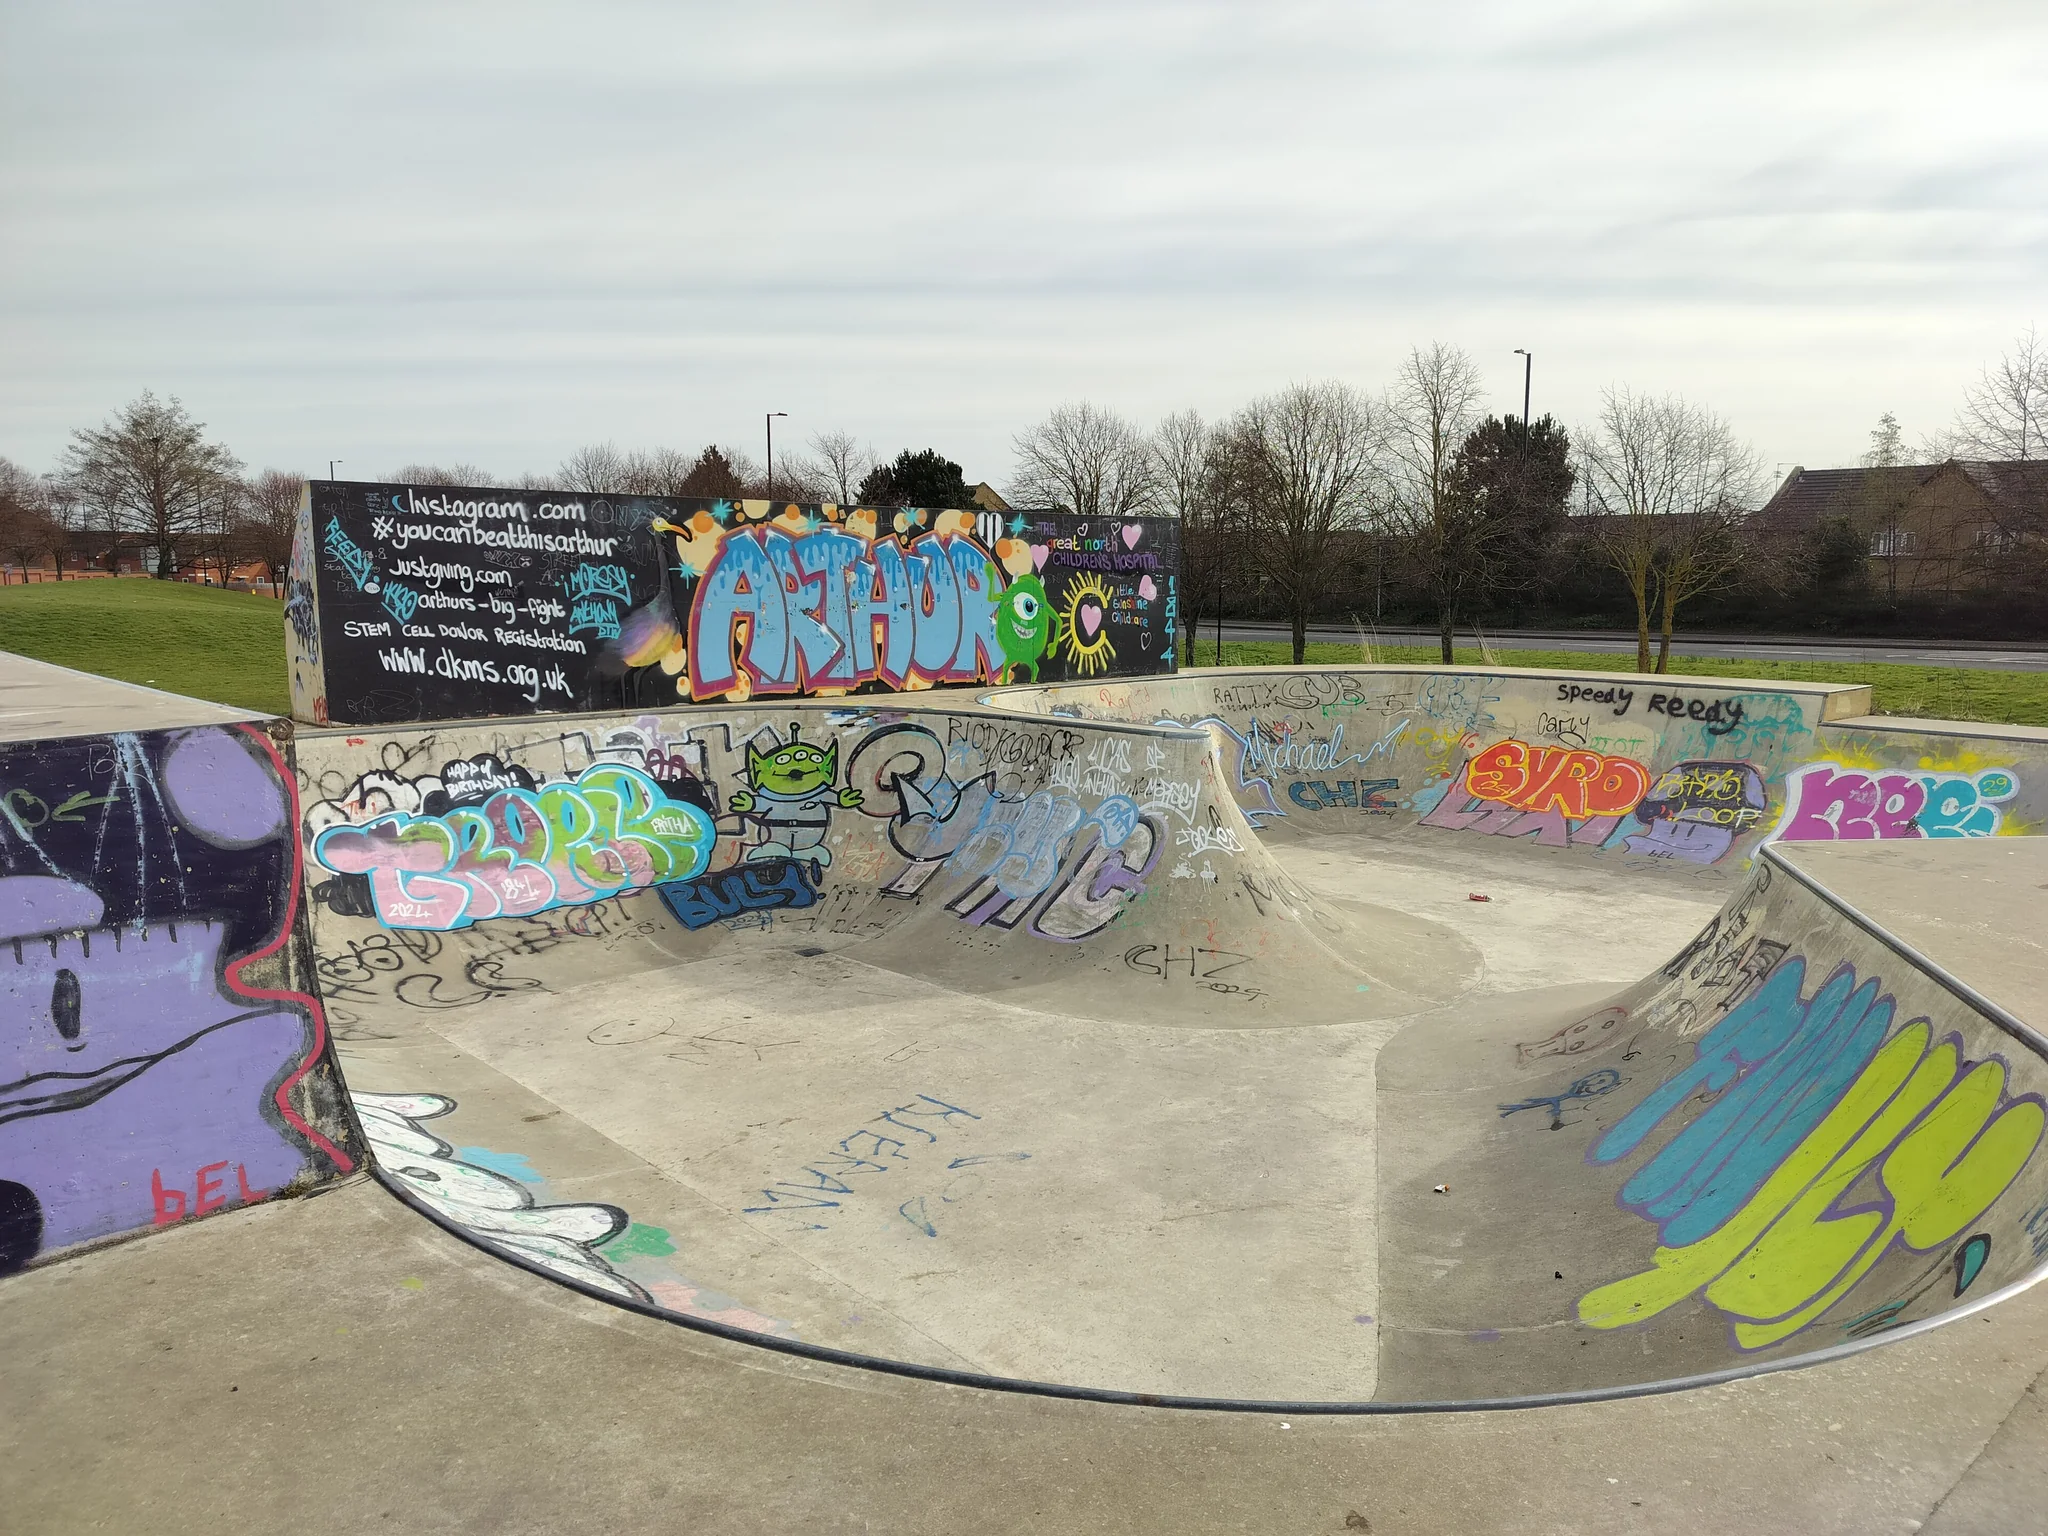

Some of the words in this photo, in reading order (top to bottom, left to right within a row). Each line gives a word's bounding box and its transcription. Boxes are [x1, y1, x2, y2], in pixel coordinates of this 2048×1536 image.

[371, 514, 619, 557] #youcanbeatthisarthur
[1047, 534, 1081, 554] great
[1084, 536, 1119, 553] north
[1114, 554, 1165, 571] HOSPITAL
[687, 521, 1008, 701] ARTHUR
[343, 620, 392, 638] STEM
[402, 624, 436, 639] CELL
[440, 624, 489, 643] DONOR
[446, 759, 493, 781] HAPPY
[388, 902, 433, 918] 2024
